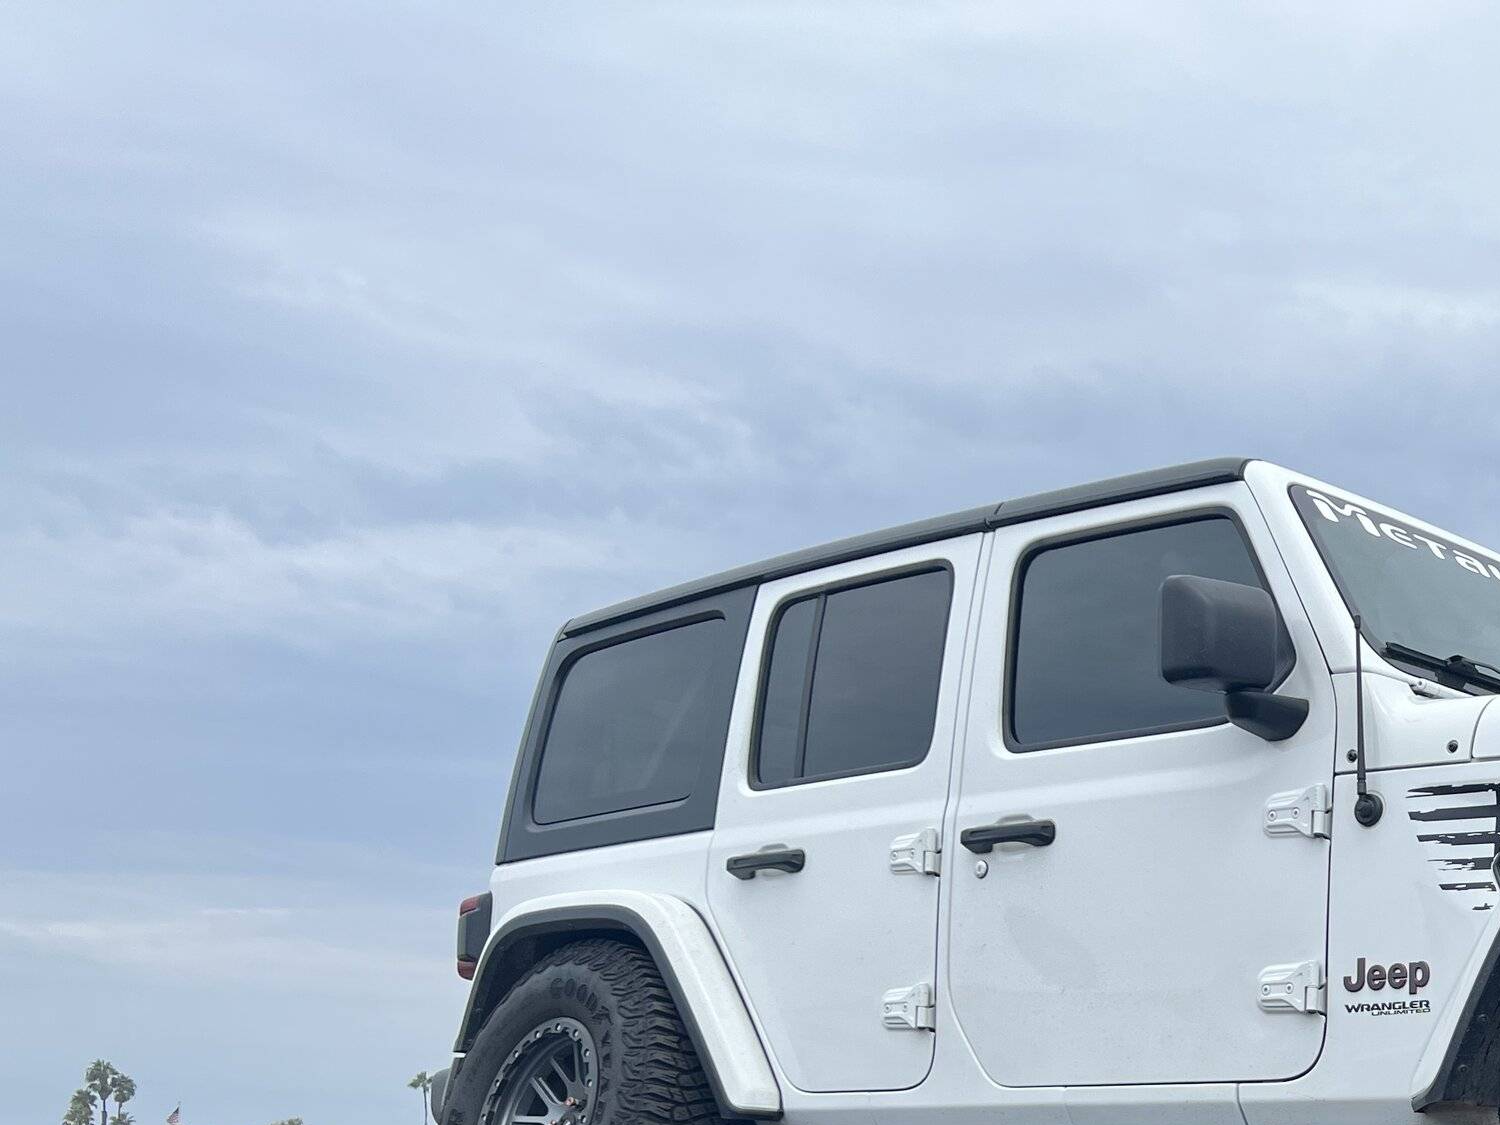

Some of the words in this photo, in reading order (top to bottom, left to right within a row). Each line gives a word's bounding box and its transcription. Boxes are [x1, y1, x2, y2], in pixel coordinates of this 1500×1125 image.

[1343, 957, 1430, 995] Jeep
[1345, 999, 1430, 1013] WRANGLER
[1371, 1008, 1431, 1017] UNLIMITED
